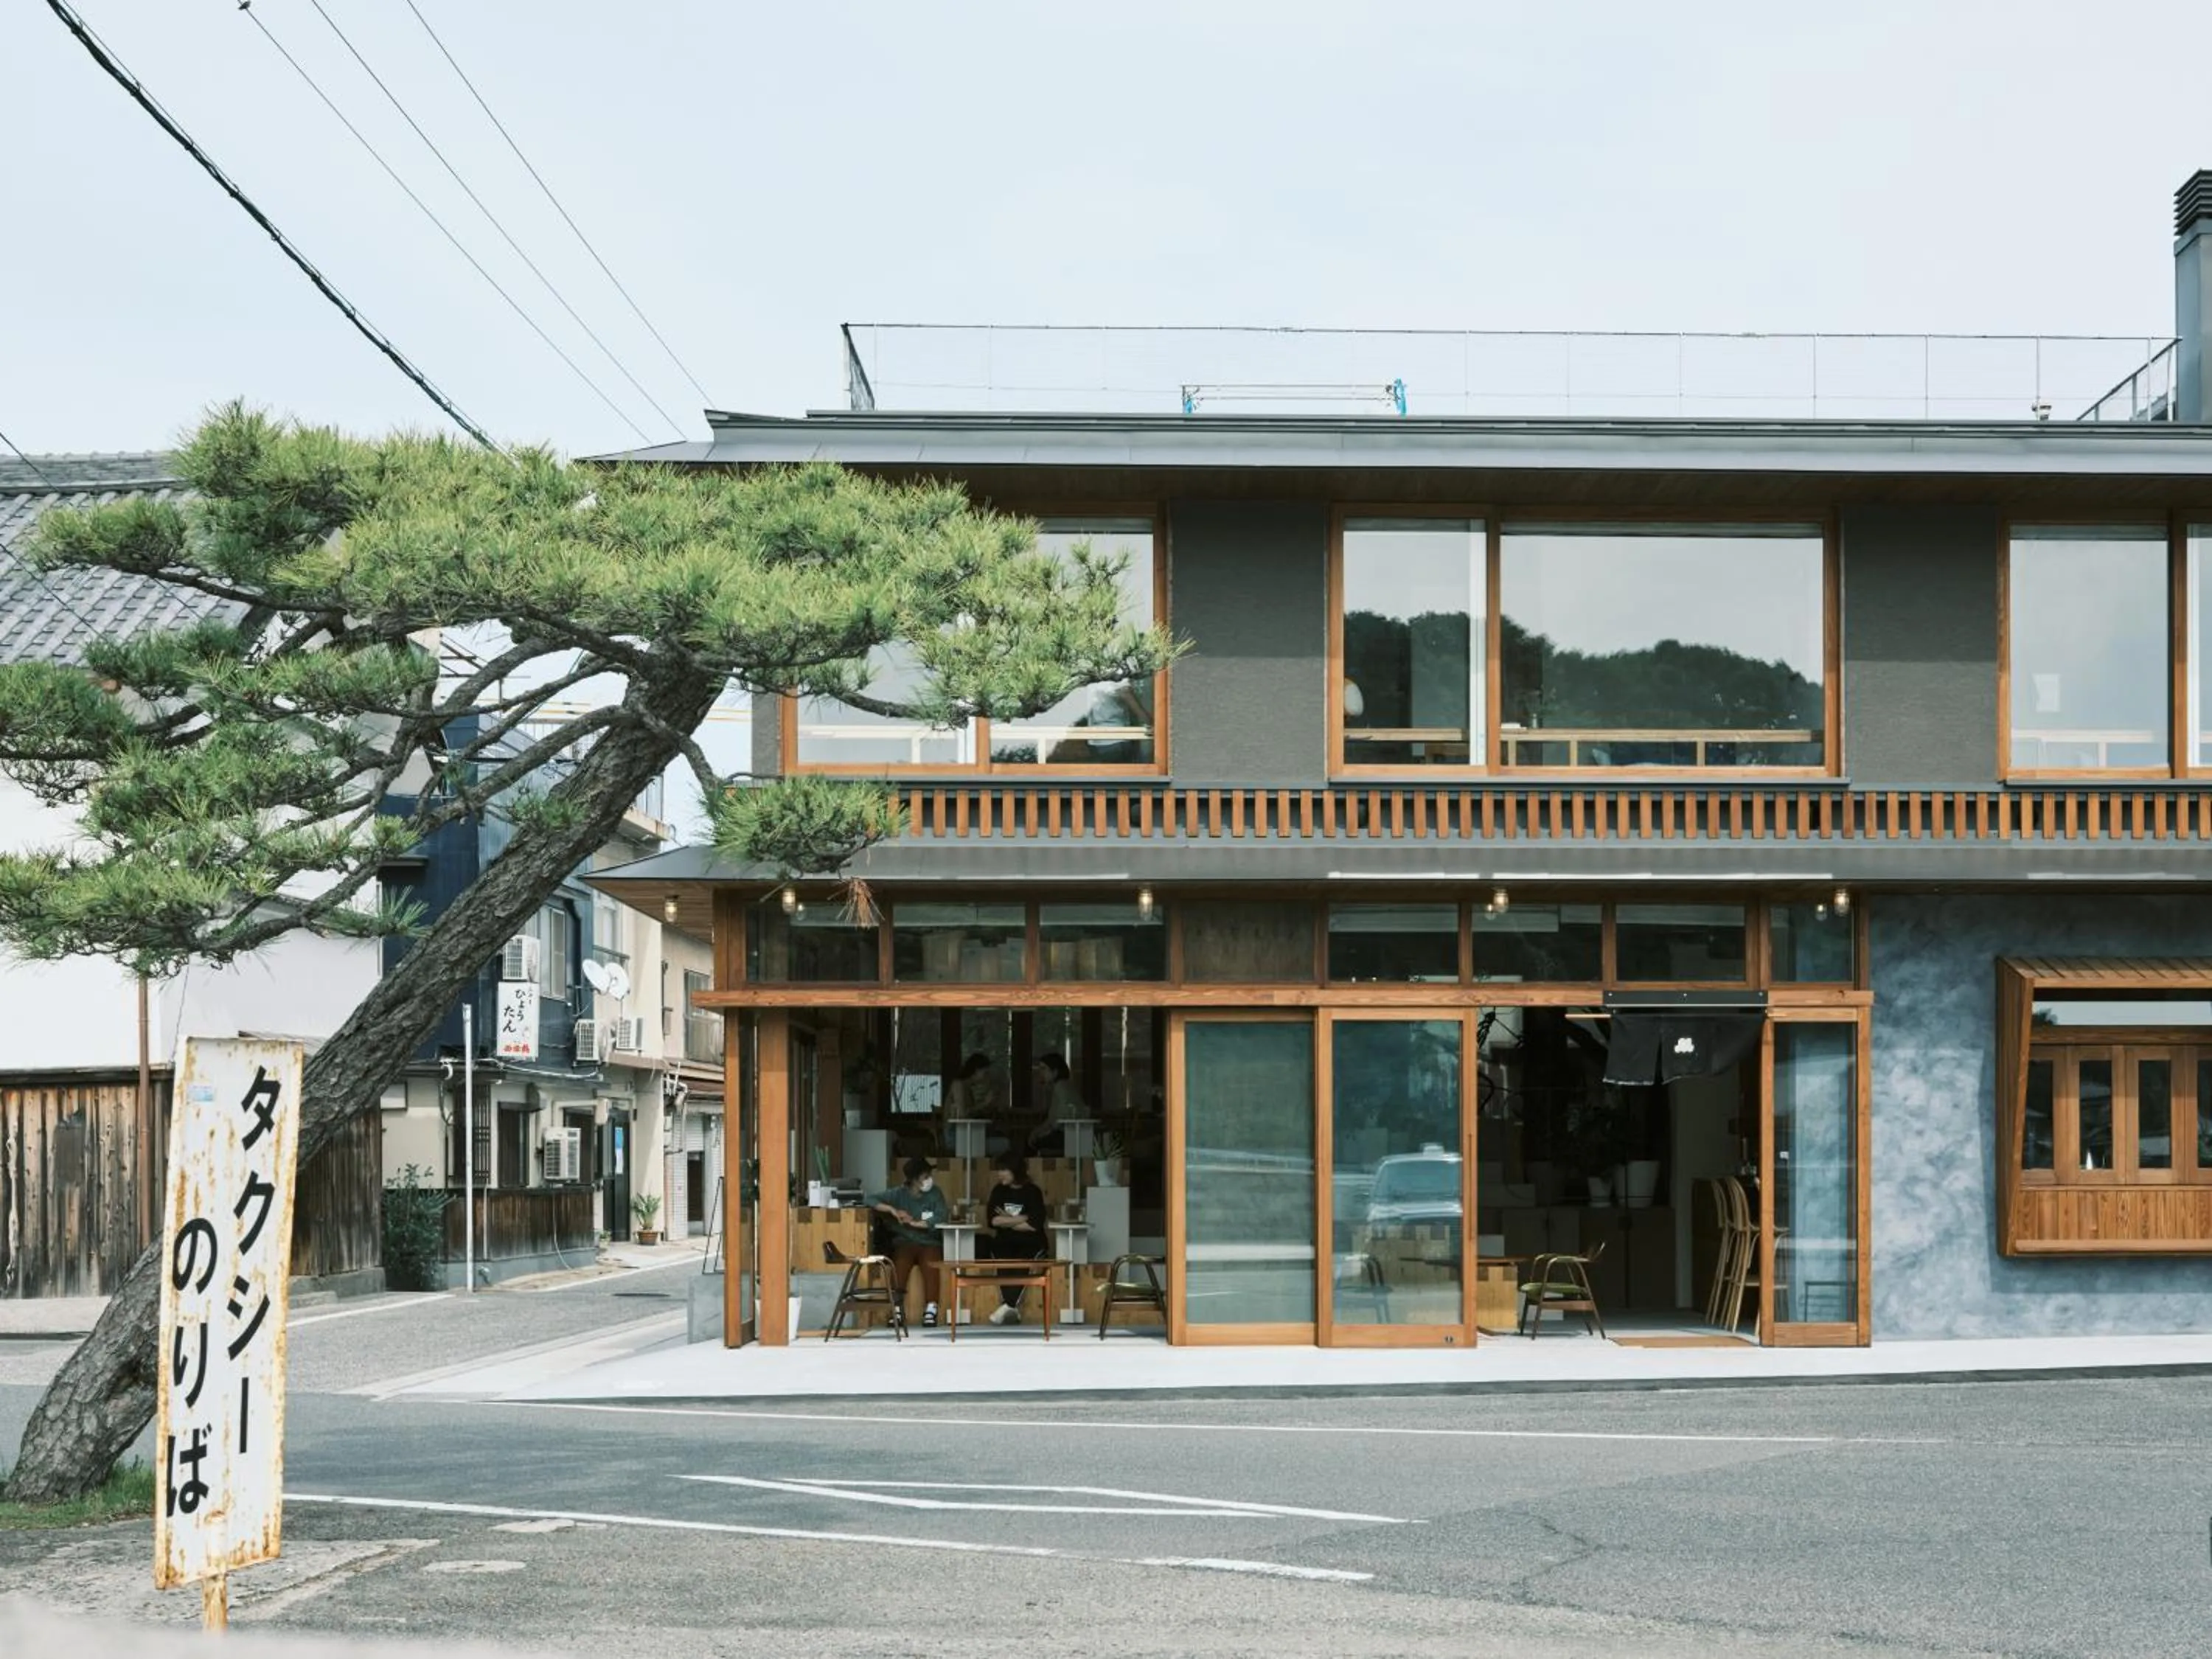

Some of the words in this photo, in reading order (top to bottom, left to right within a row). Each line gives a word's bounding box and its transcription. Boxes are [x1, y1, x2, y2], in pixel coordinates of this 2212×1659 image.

[503, 1004, 516, 1033] たん
[515, 989, 526, 1021] ひょう
[227, 1065, 282, 1454] タクシー
[165, 1217, 218, 1518] のりば
